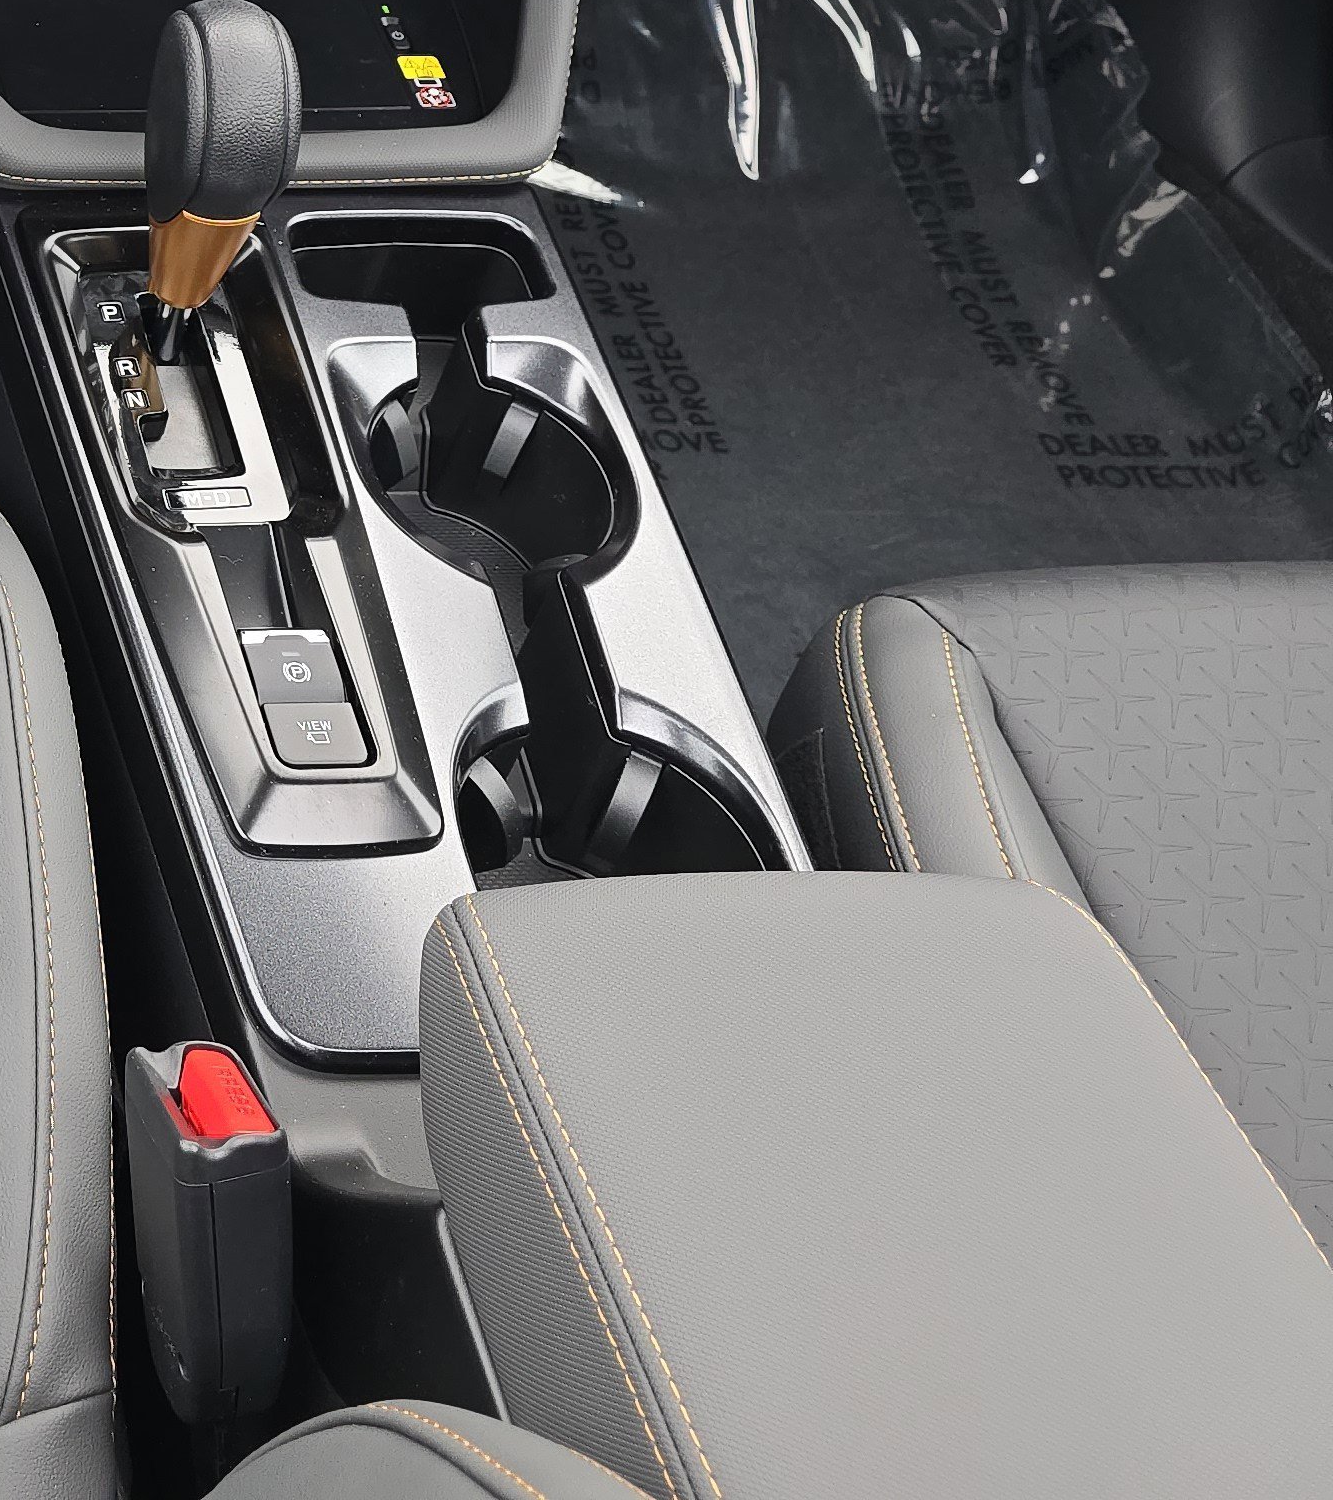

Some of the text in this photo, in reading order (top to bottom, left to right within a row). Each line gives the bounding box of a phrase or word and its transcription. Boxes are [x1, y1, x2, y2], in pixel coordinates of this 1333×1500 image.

[918, 113, 976, 211] DEALER
[960, 229, 1021, 310] MUST
[881, 111, 1019, 369] PROTECTIVE COVER
[568, 246, 626, 320] MUST
[101, 303, 119, 322] P
[118, 358, 136, 376] R
[610, 332, 682, 428] DEALER
[619, 280, 718, 428] PROTECTIVE
[127, 391, 145, 409] N
[1038, 433, 1169, 457] DEALER
[1186, 401, 1281, 457] MUST
[1055, 459, 1266, 490] PROTECTIVE
[296, 719, 333, 732] VIEW
